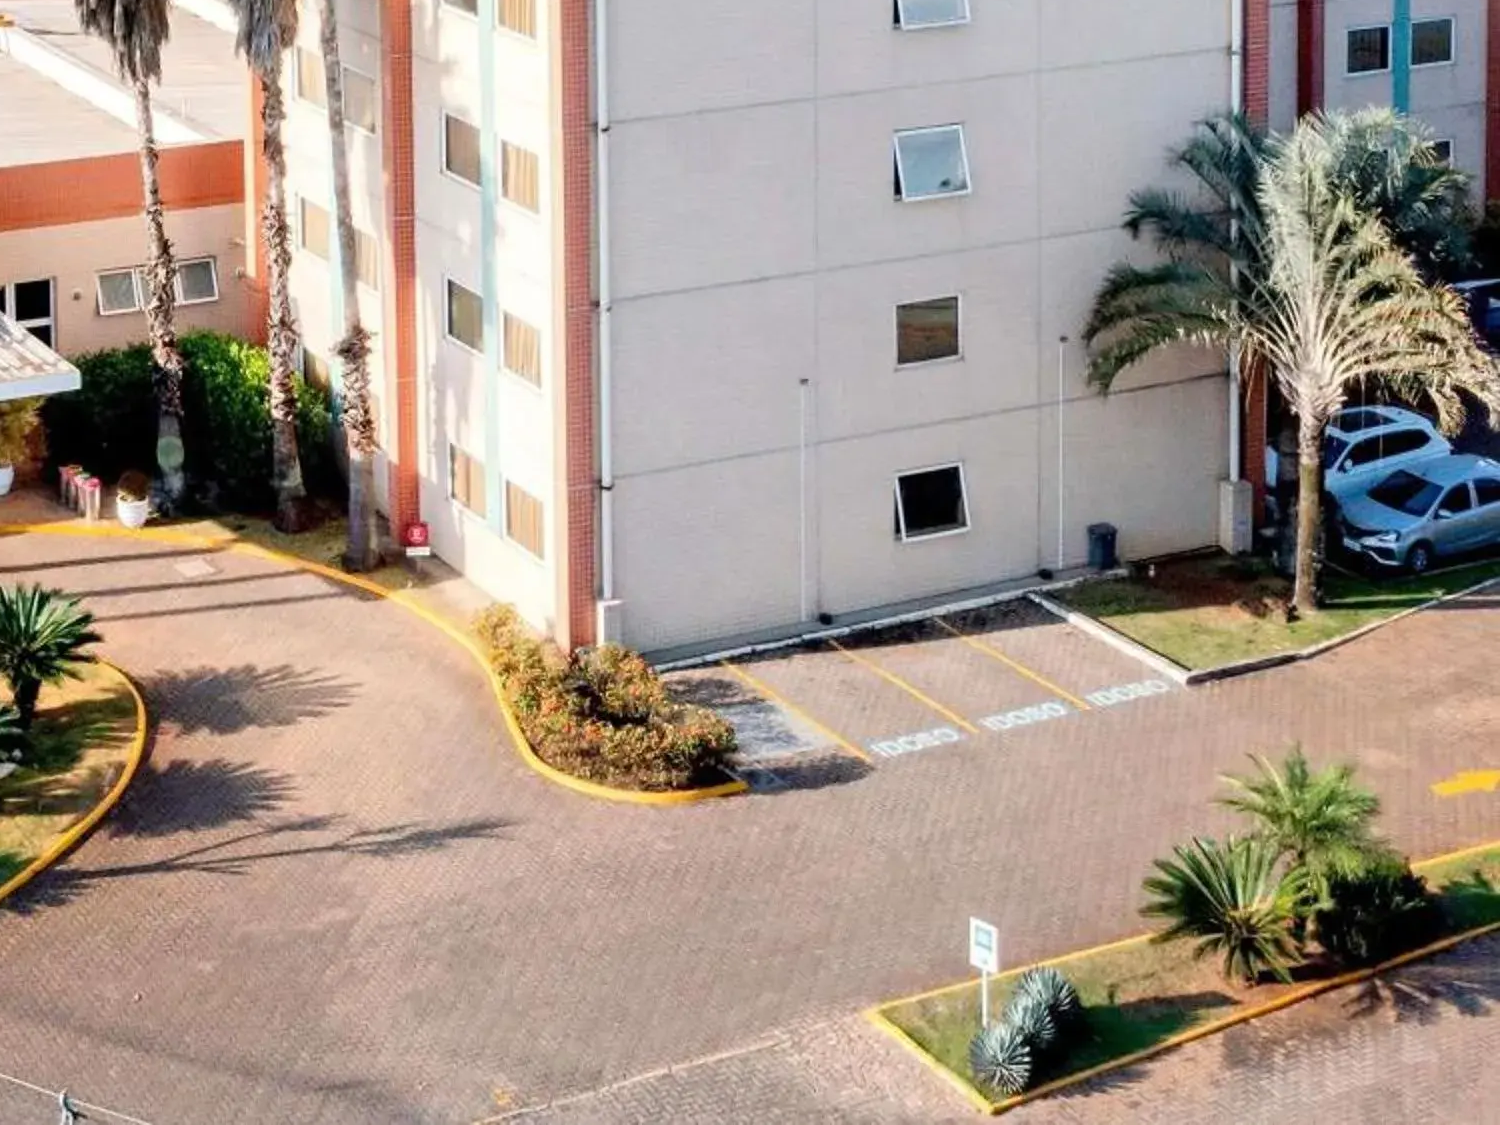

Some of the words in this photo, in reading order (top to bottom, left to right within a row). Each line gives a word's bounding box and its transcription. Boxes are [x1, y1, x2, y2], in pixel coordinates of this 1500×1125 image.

[1085, 679, 1170, 706] IDOSO
[977, 702, 1068, 731] IDOSO
[870, 728, 960, 757] IDOSO
